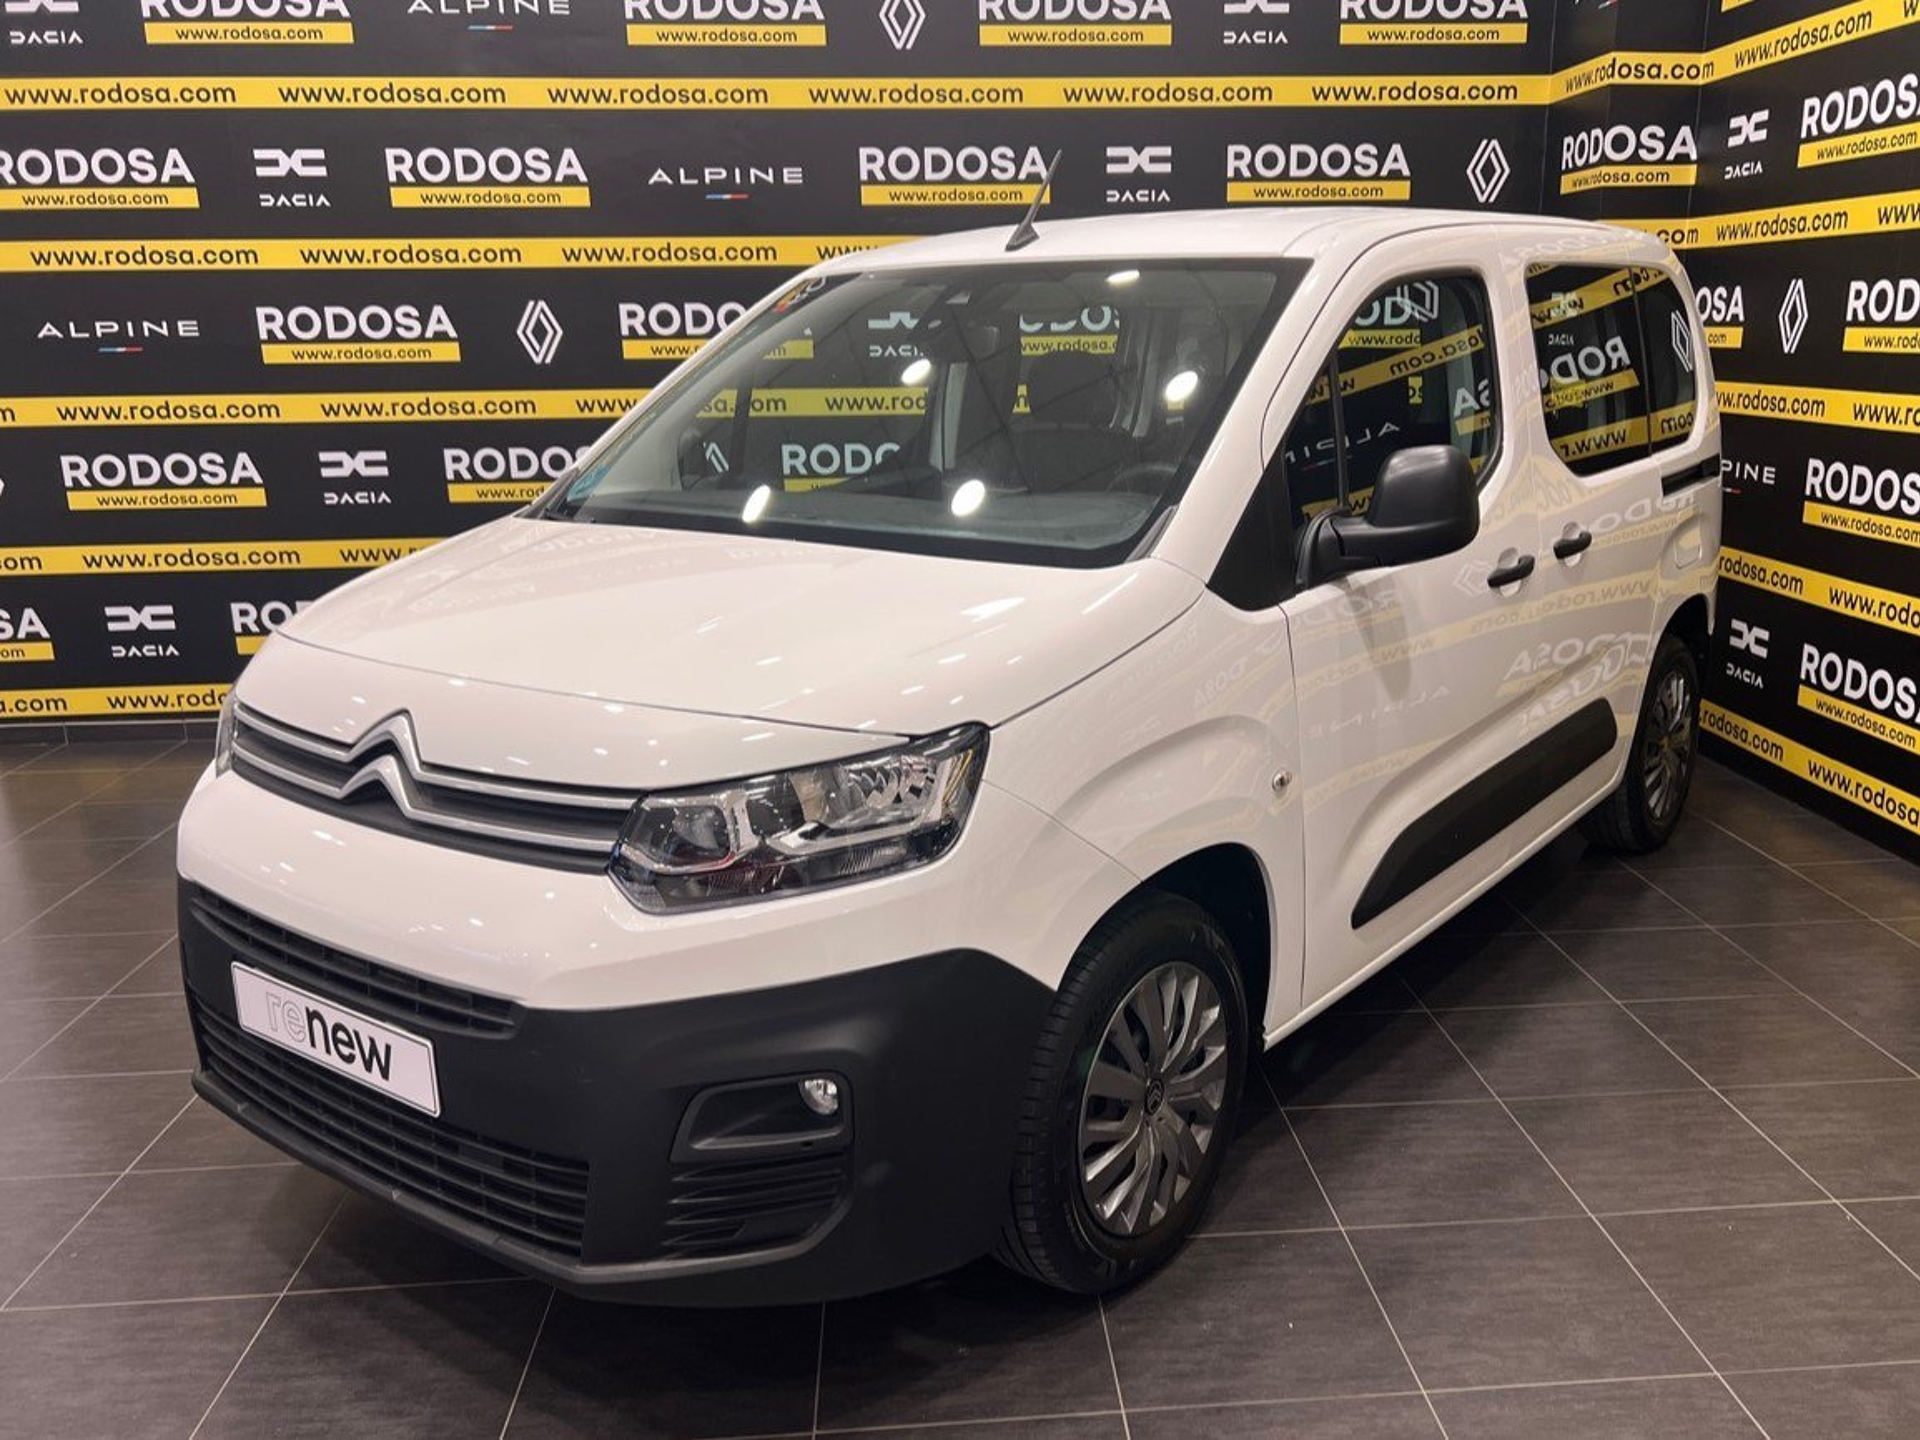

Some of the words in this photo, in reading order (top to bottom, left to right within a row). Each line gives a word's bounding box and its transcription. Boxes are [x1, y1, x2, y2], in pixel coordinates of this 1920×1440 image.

[406, 0, 572, 15] ALPINE
[9, 31, 84, 45] DACIA
[175, 26, 324, 42] www.rodosa.com
[655, 28, 798, 44] www.rodosa.com
[1007, 29, 1145, 44] www.rodosa.com
[1223, 31, 1288, 45] DACIA
[1366, 27, 1500, 42] www.rodosa.com
[1565, 57, 1715, 93] www.rodosa.com
[1734, 9, 1873, 68] www.rodosa.com
[4, 83, 237, 106] www.rodosa.com
[278, 83, 507, 105] www.rodosa.com
[547, 83, 769, 105] www.rodosa.com
[808, 84, 1024, 104] www.rodosa.com
[1063, 82, 1273, 103] www.rodosa.com
[1311, 81, 1518, 101] www.rodosa.com
[1800, 72, 1920, 138] RODOS
[1561, 125, 1698, 170] RODOSA
[1816, 131, 1919, 160] www.rodosa.com
[384, 147, 588, 183] RODOSA
[858, 146, 1048, 181] RODOSA
[1226, 143, 1411, 178] RODOSA
[1723, 160, 1763, 181] DACIA
[648, 167, 803, 184] ALPINE
[21, 190, 170, 206] www.rodosa.com
[258, 194, 331, 208] DACIA
[419, 190, 562, 205] www.rodosa.com
[888, 188, 1024, 203] www.rodosa.com
[1106, 190, 1171, 203] DACIA
[1253, 185, 1384, 199] www.rodosa.com
[1716, 209, 1849, 241] www.rodosa.com
[30, 244, 260, 267] www.rodosa.com
[299, 243, 522, 266] www.rodosa.com
[561, 242, 778, 264] www.rodosa.com
[37, 320, 201, 339] ALPINE
[255, 304, 459, 341] RODOSA
[618, 302, 748, 336] RODO
[291, 345, 432, 362] www.rodosa.com
[56, 399, 281, 421] www.rodosa.com
[320, 396, 537, 417] www.rodosa.com
[60, 452, 264, 488] RODOSA
[1721, 459, 1776, 485] PINE
[96, 490, 238, 507] www.rodosa.com
[324, 491, 391, 505] DACIA
[1804, 457, 1920, 516] RODOS
[82, 548, 301, 571] www.rodosa.com
[1719, 553, 1804, 595] rodosa.com
[1829, 586, 1920, 628] www.rodo
[111, 644, 179, 658] DACIA
[1726, 662, 1763, 689] DACIA
[1801, 643, 1920, 722] RODOS
[1816, 698, 1916, 748] www.rodosa.com
[1808, 759, 1920, 827] www.rodosa
